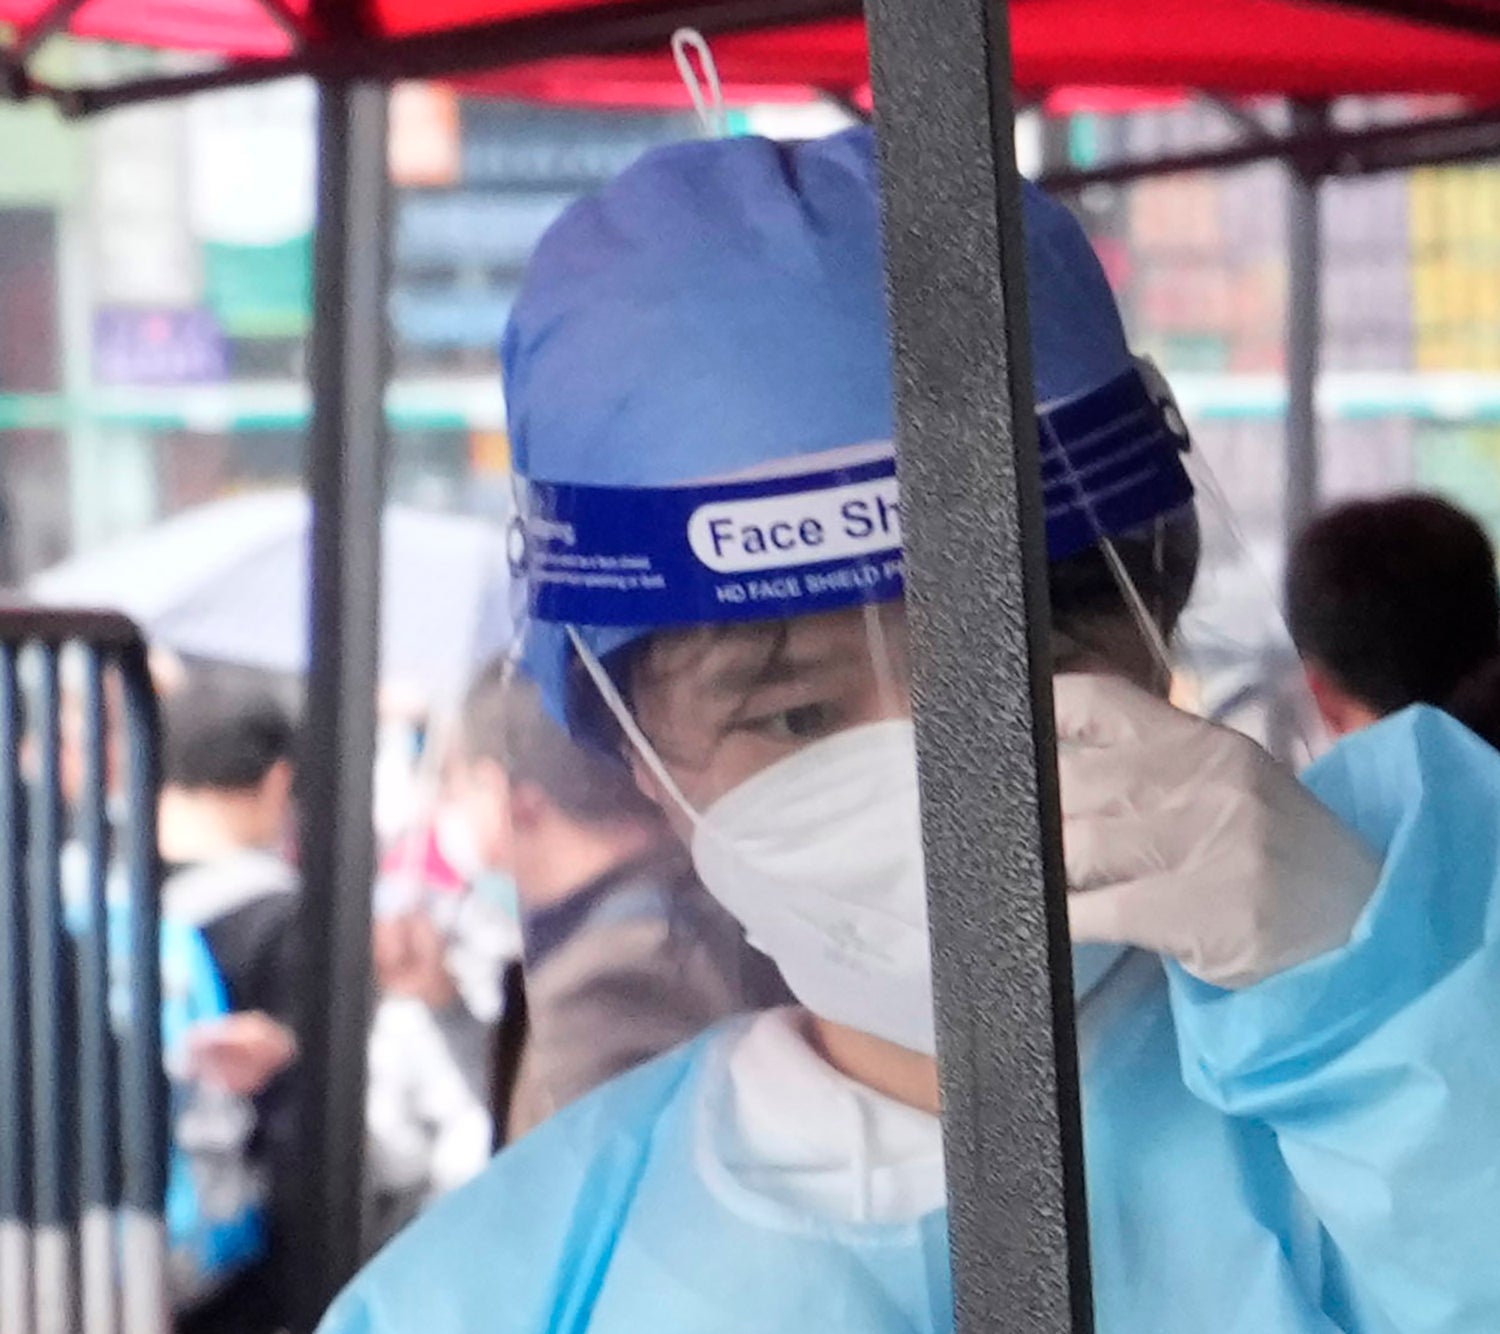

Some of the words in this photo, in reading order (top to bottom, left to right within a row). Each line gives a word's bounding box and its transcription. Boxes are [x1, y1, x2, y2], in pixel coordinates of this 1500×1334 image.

[708, 517, 826, 558] Face
[715, 583, 746, 603] HD
[748, 577, 802, 602] FACE
[805, 564, 881, 593] SHIELD
